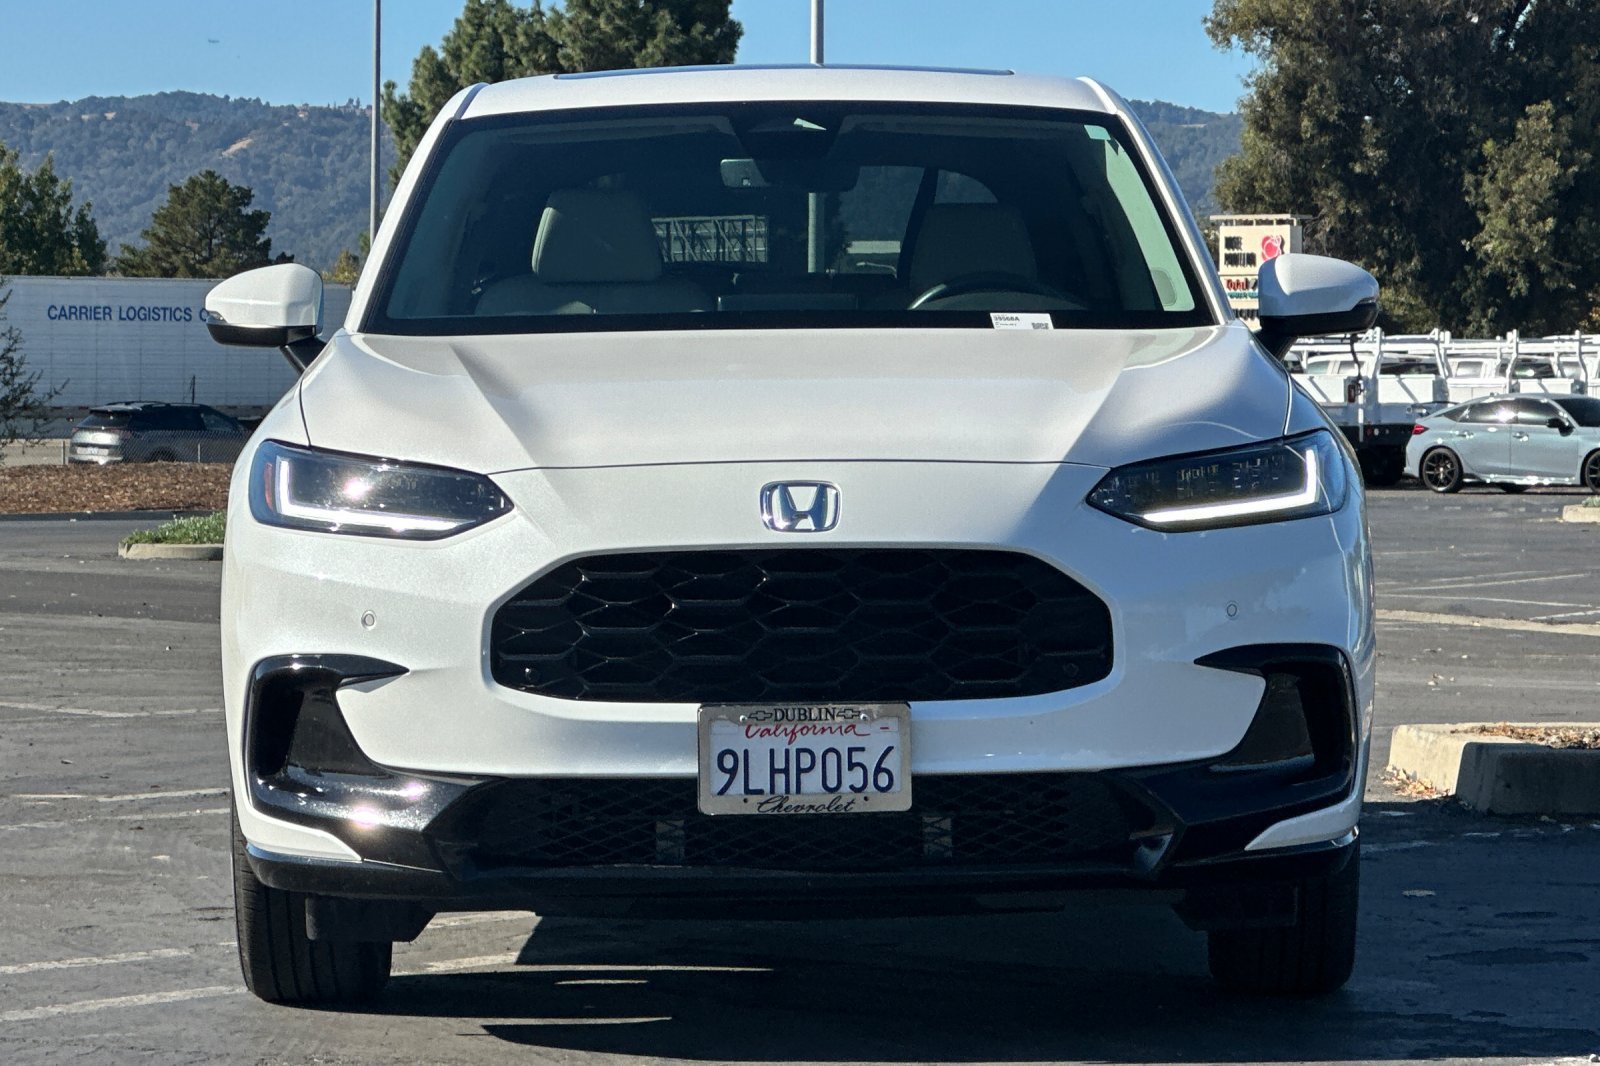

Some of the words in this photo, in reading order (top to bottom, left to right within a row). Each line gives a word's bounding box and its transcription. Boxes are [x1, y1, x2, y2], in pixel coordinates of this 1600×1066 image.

[48, 305, 112, 321] CARRIER
[118, 306, 193, 322] LOGISTICS
[773, 707, 836, 722] DUBLIN
[745, 723, 871, 745] California
[717, 746, 895, 796] 9LHP056
[757, 795, 856, 814] Chevrolet
